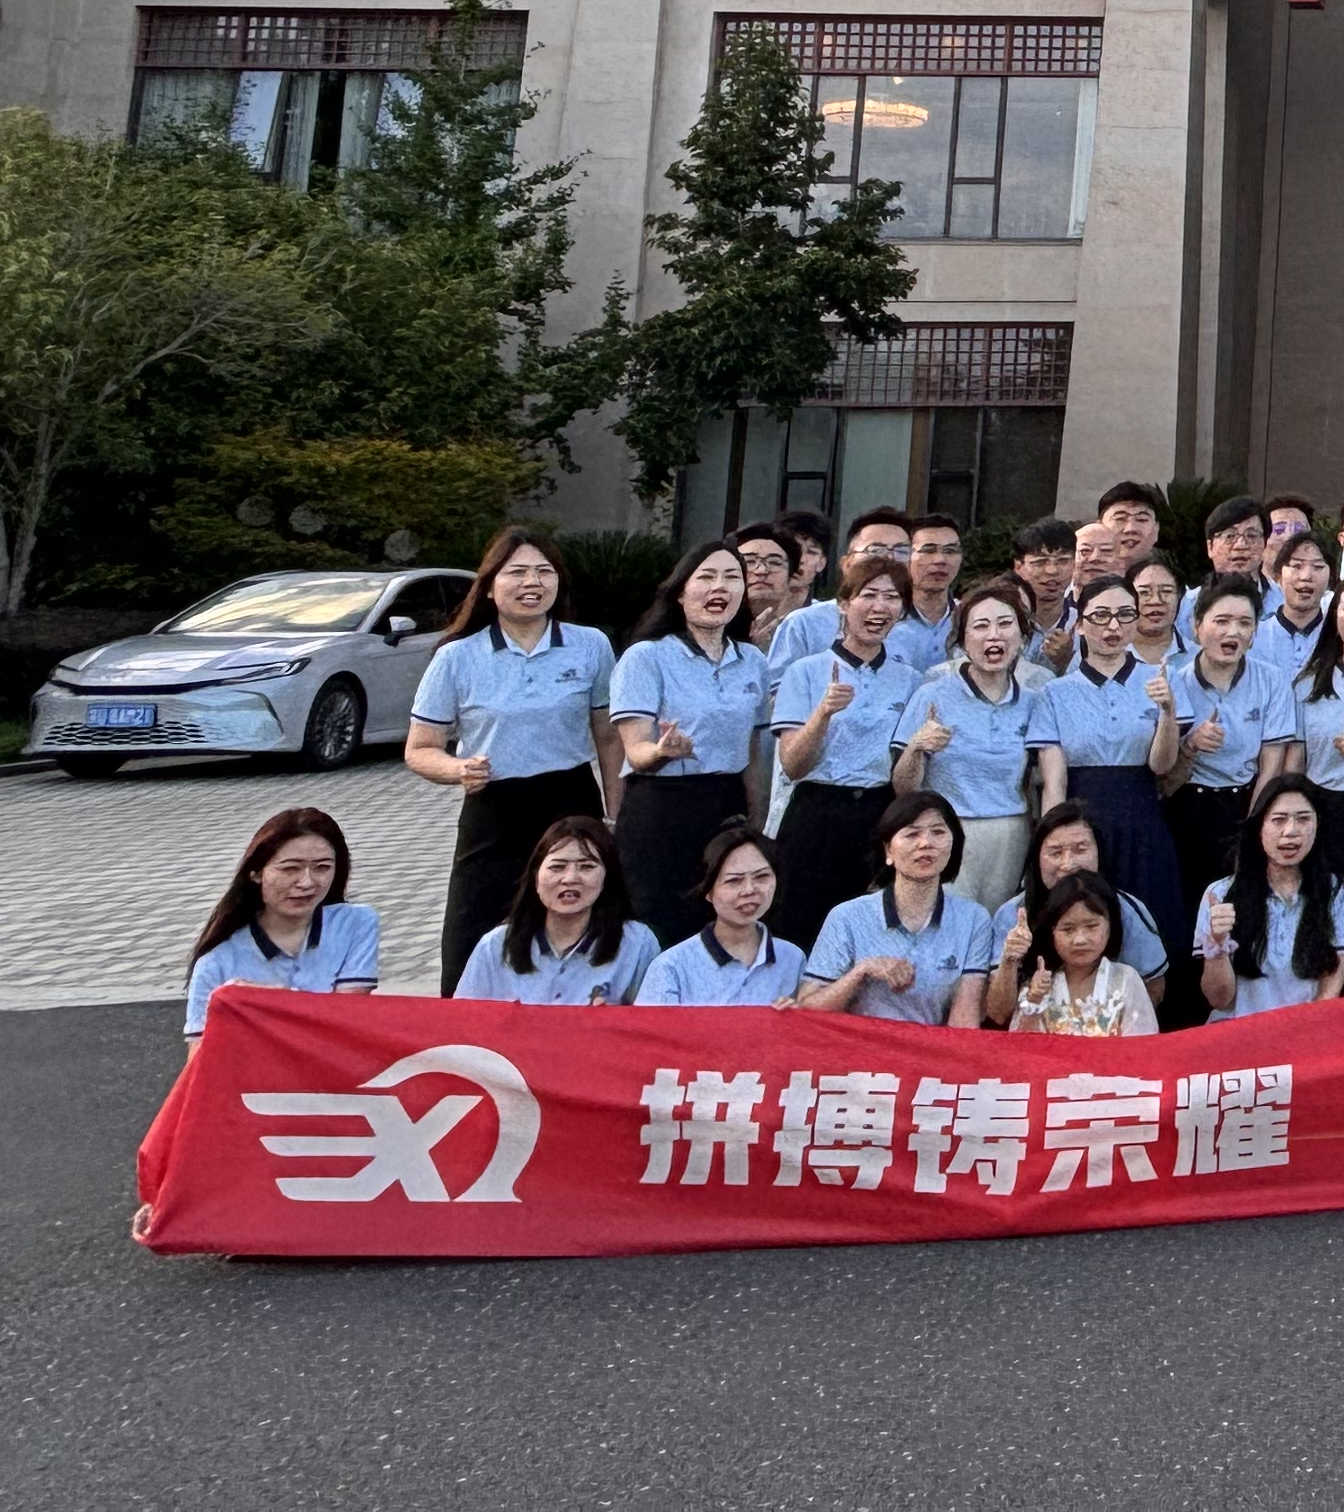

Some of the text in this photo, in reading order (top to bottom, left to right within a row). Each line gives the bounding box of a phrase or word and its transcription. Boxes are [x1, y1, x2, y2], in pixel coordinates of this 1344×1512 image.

[640, 1064, 1292, 1195] 拼搏铸荣耀
